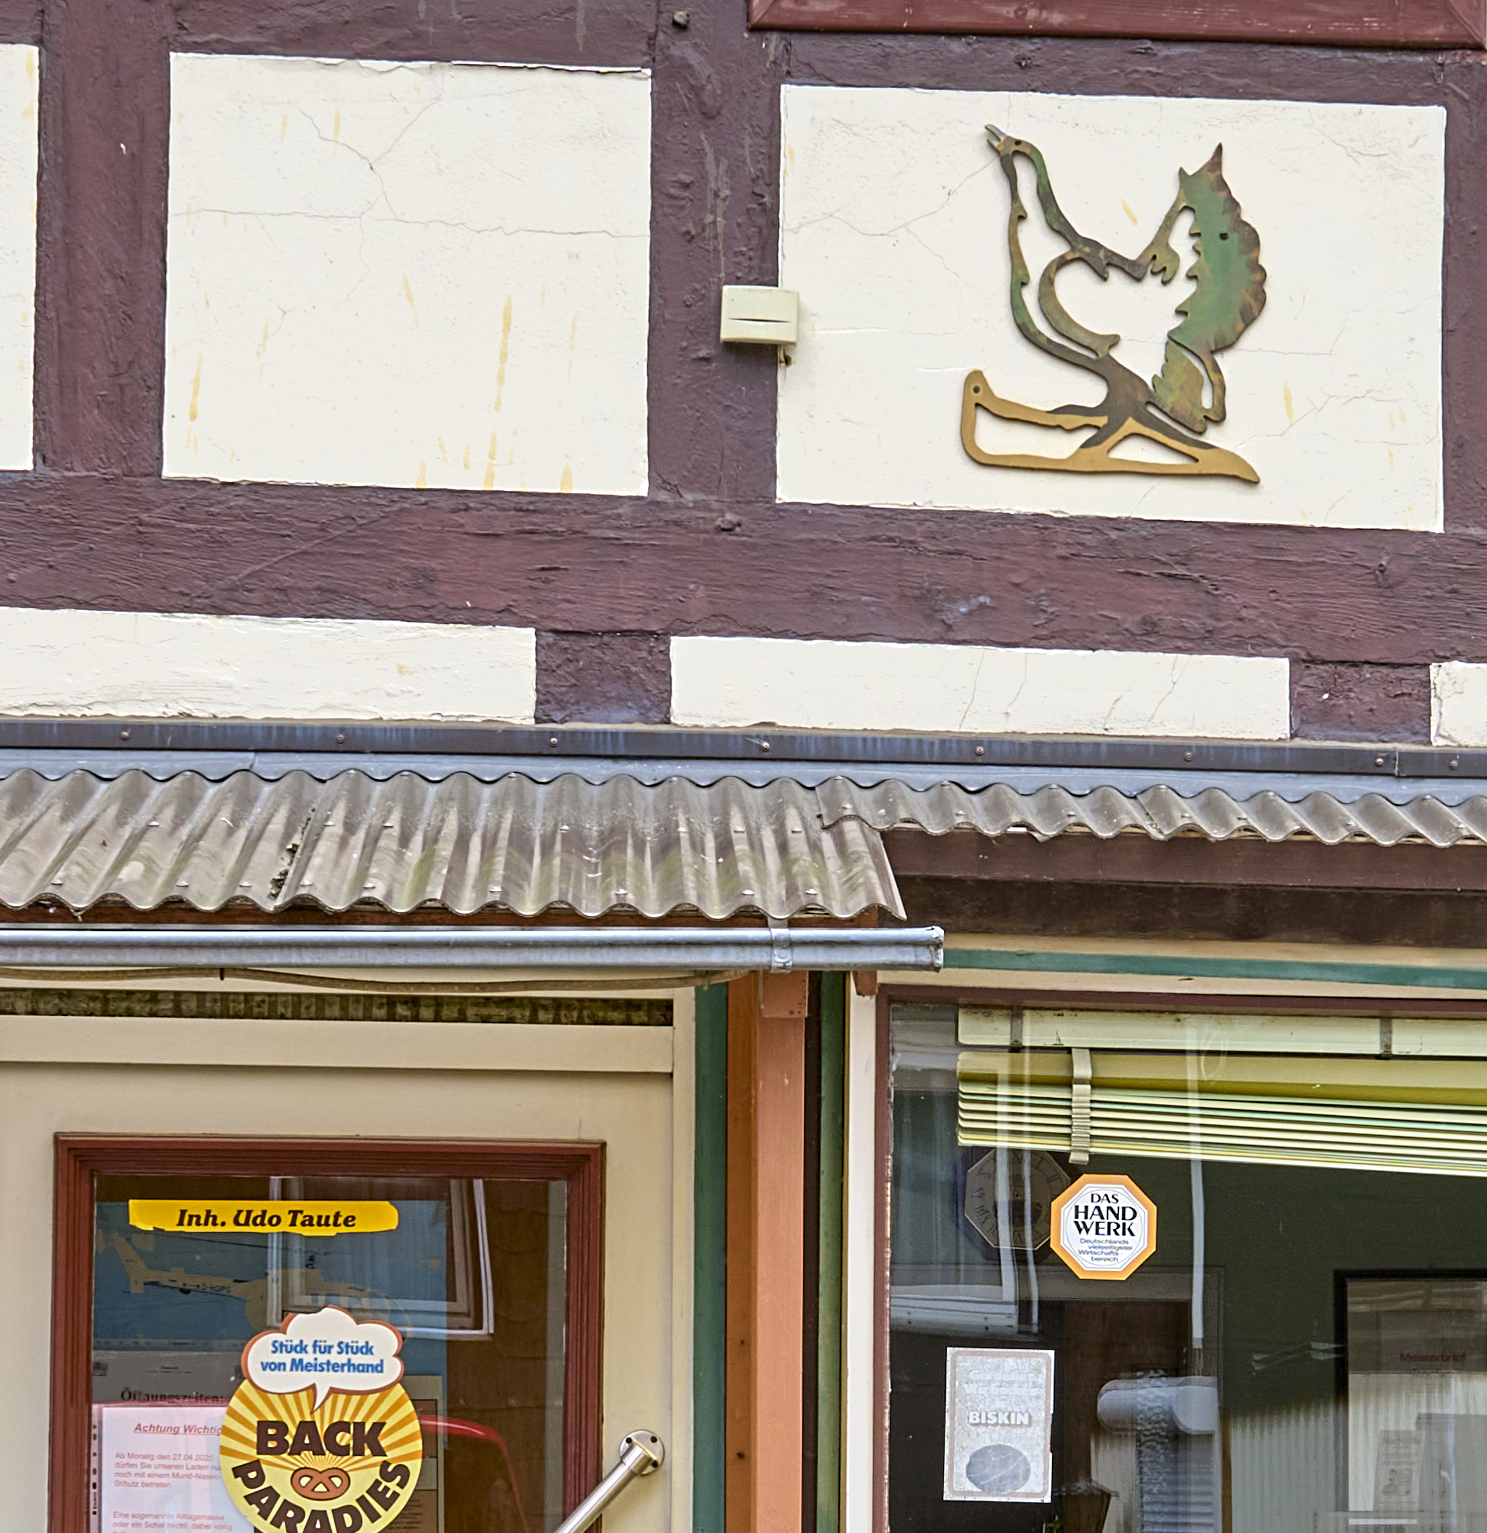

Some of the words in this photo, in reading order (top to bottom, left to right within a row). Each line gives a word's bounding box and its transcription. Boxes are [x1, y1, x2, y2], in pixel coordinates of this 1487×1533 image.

[1091, 1193, 1119, 1203] DAS
[176, 1209, 226, 1227] Inh.
[233, 1209, 282, 1227] Udo
[288, 1210, 357, 1228] Taute
[1074, 1205, 1137, 1220] HAND
[1074, 1221, 1136, 1236] WERK
[271, 1340, 308, 1356] Stück
[313, 1340, 334, 1356] für
[337, 1340, 374, 1356] Stück
[261, 1360, 286, 1372] von
[289, 1357, 385, 1374] Meisterhand
[968, 1411, 1031, 1427] BISKIN
[134, 1423, 180, 1435] Achtung
[256, 1420, 387, 1457] BACK
